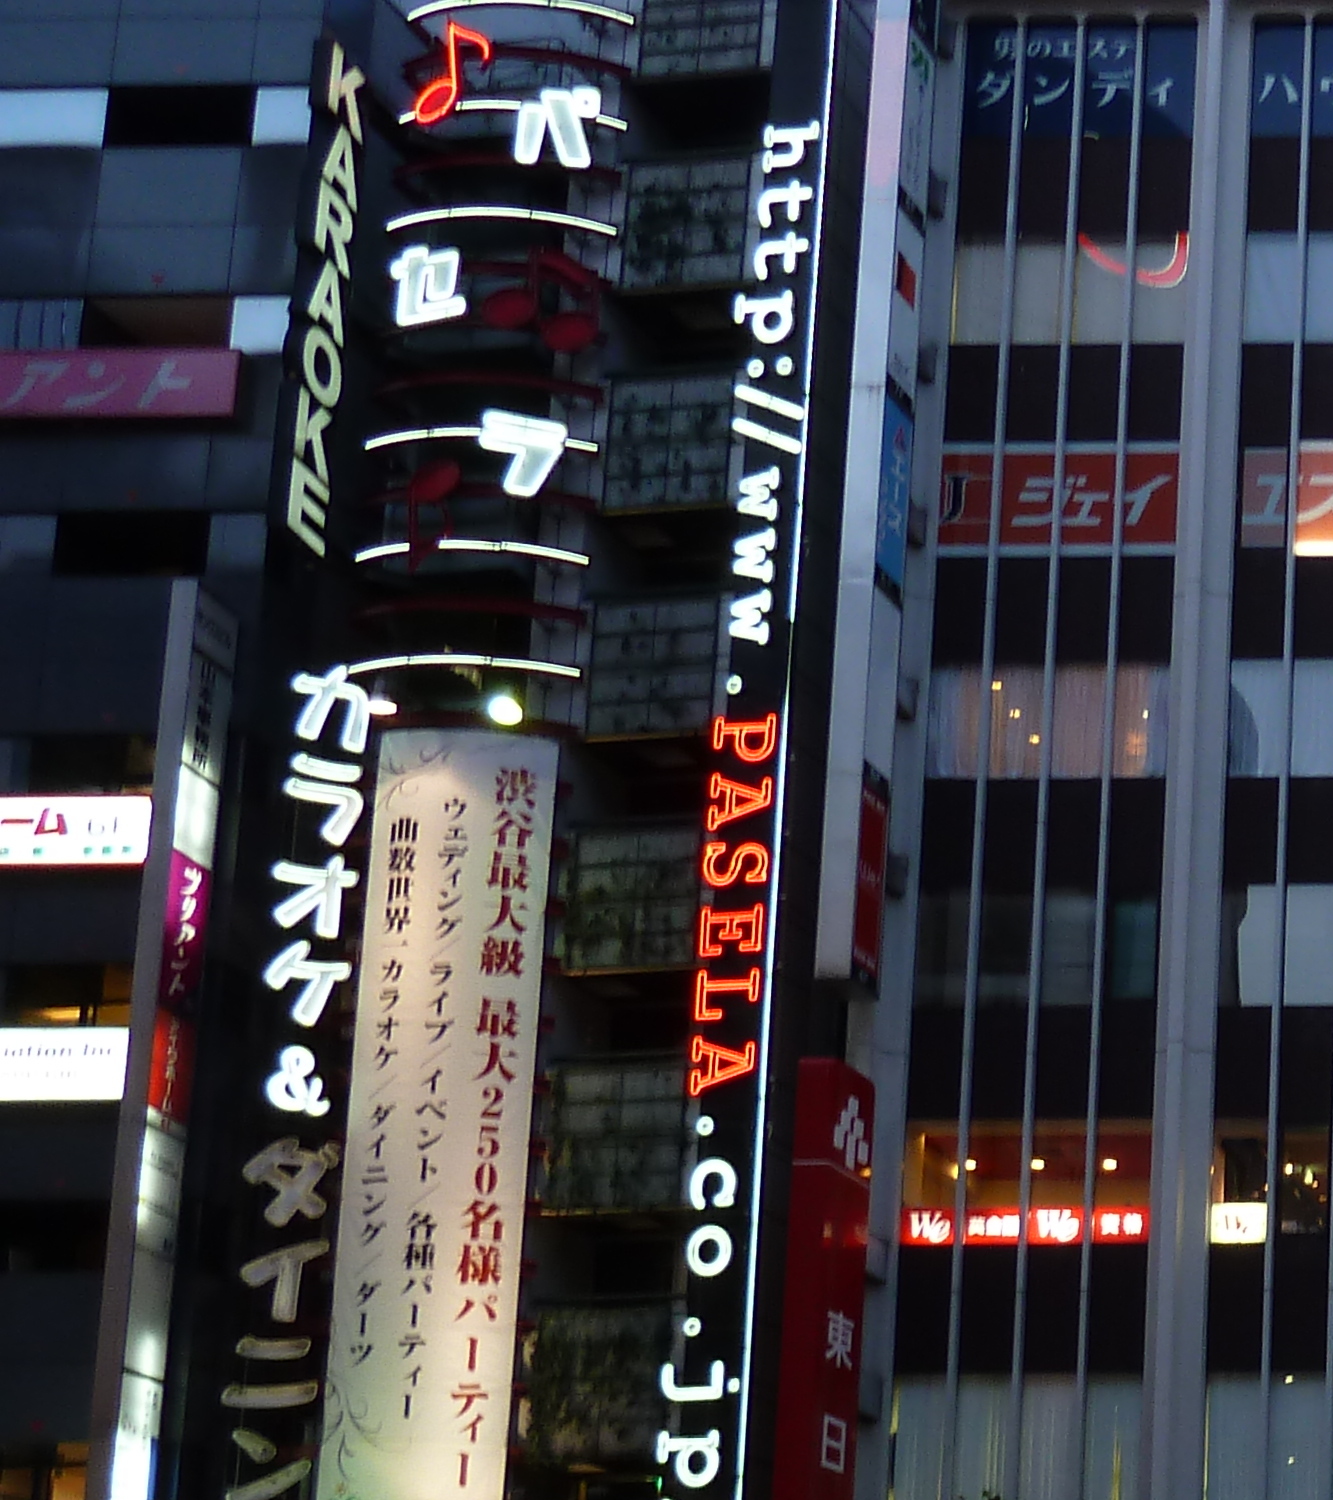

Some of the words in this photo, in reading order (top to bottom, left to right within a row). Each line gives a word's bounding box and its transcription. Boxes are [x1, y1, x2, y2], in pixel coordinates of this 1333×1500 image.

[288, 42, 366, 557] KARAOKE
[1011, 474, 1172, 528] ジェイ
[480, 766, 538, 979] 渋谷最大級
